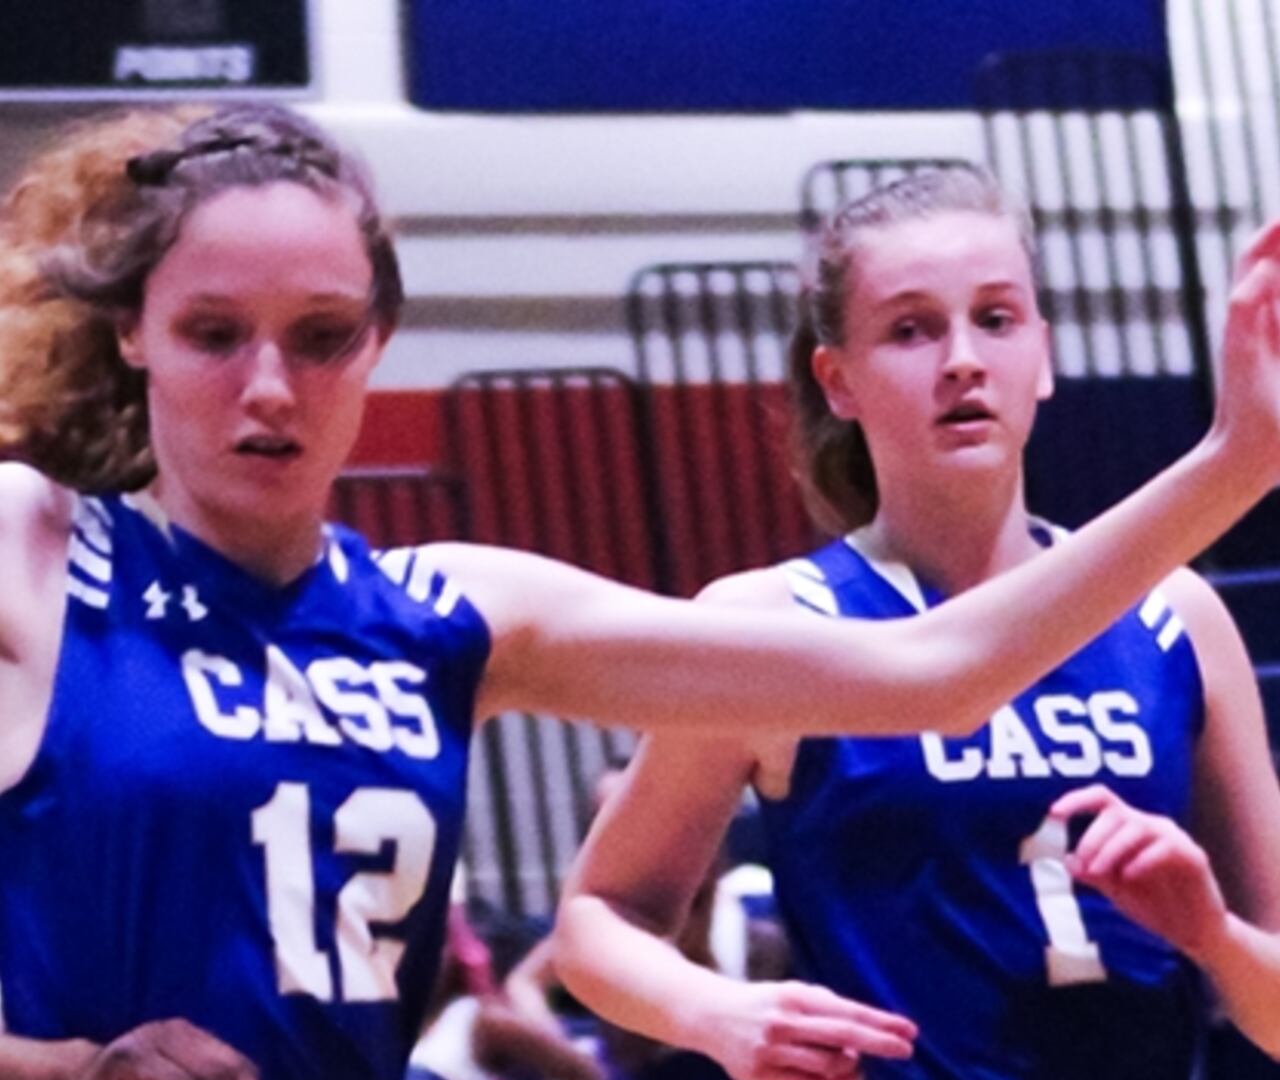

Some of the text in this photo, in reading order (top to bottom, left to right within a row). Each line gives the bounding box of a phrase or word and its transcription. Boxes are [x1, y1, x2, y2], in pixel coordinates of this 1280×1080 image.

[180, 644, 441, 760] CASS
[921, 690, 1154, 783] CASS
[250, 780, 437, 1002] 12
[1019, 812, 1108, 988] 1
